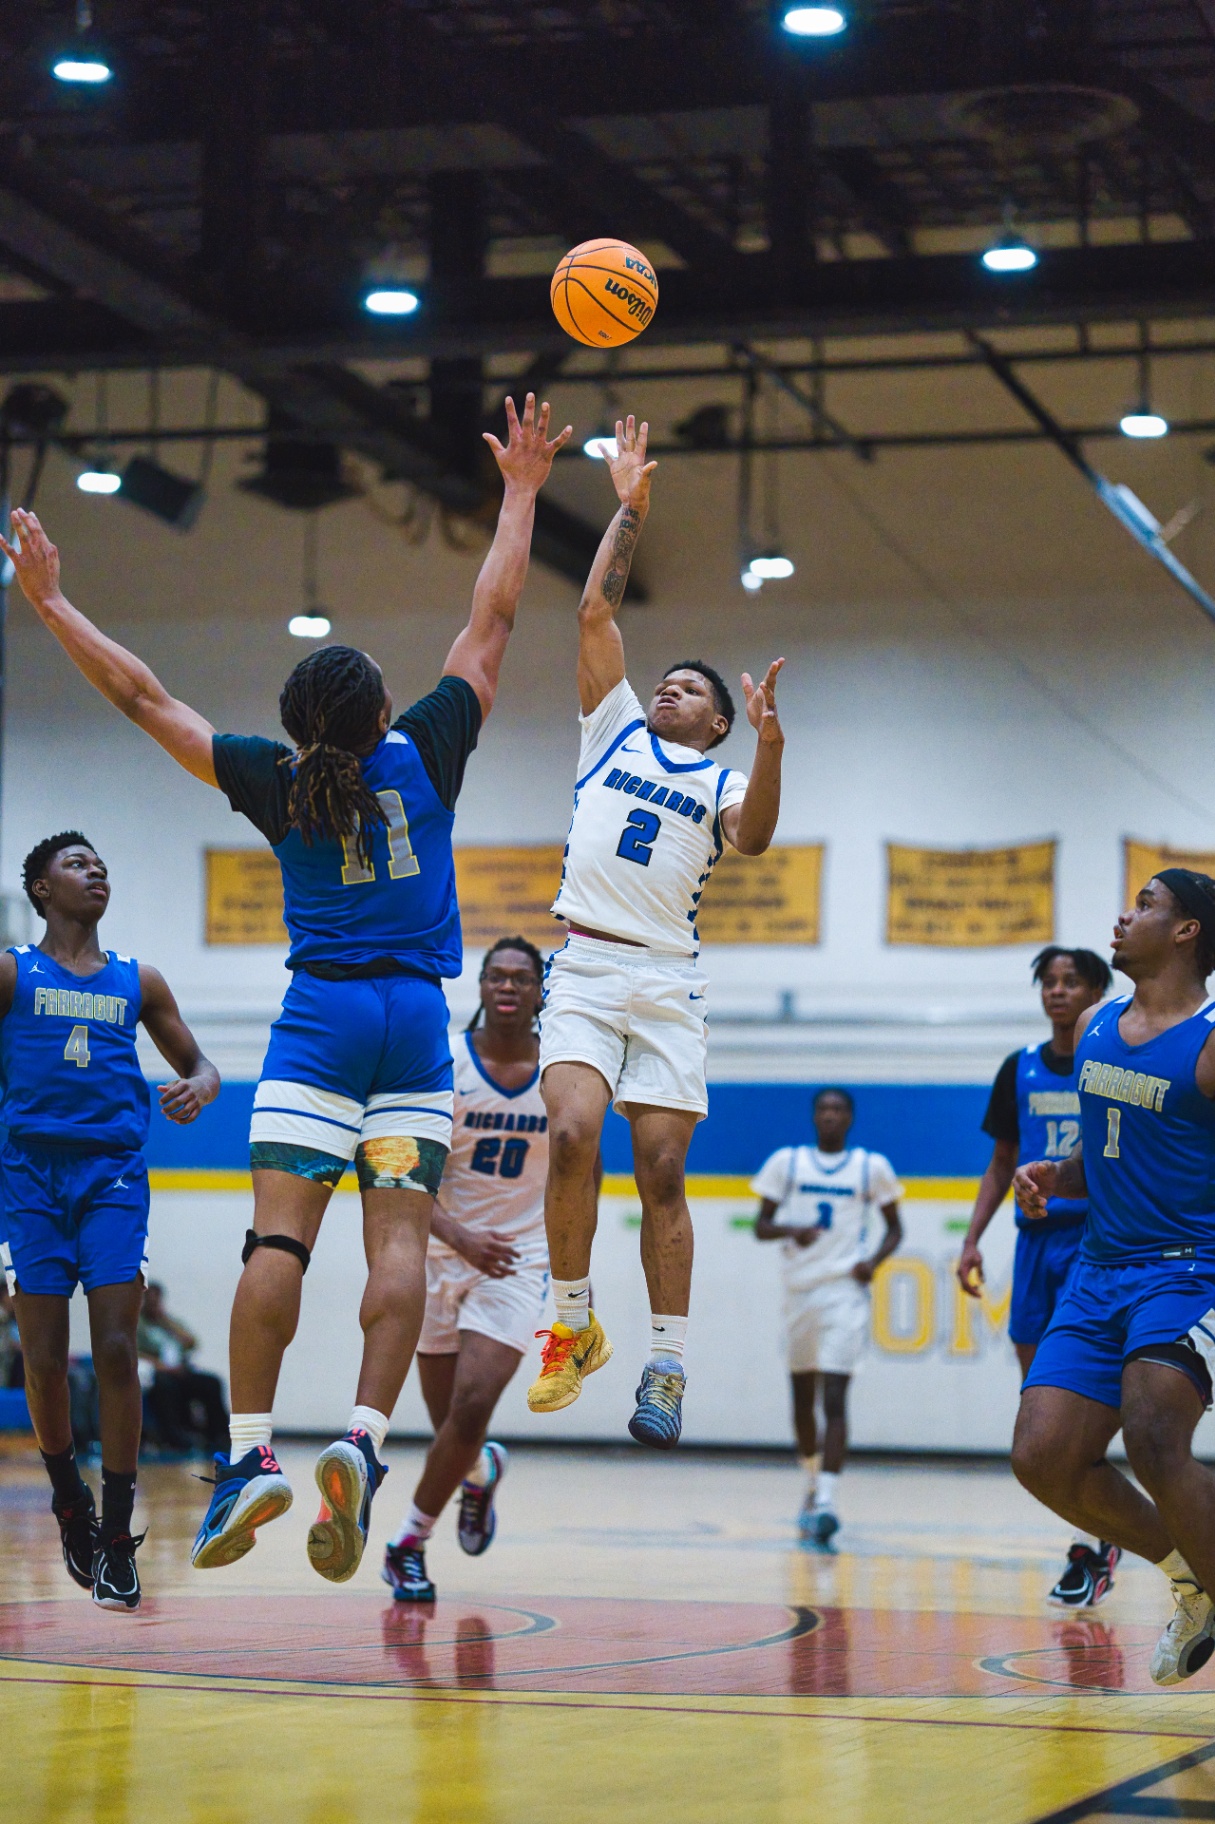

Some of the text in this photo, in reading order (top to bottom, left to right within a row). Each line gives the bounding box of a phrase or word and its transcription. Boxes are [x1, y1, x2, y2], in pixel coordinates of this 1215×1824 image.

[604, 277, 653, 326] Wilson
[602, 767, 707, 824] RICHARDS
[615, 807, 662, 868] 2
[33, 987, 128, 1026] FARRAGUT
[64, 1025, 91, 1068] 4
[1078, 1059, 1172, 1113] FARRAGUT
[1045, 1119, 1079, 1157] 12
[1103, 1107, 1121, 1159] 1
[470, 1137, 531, 1179] 20
